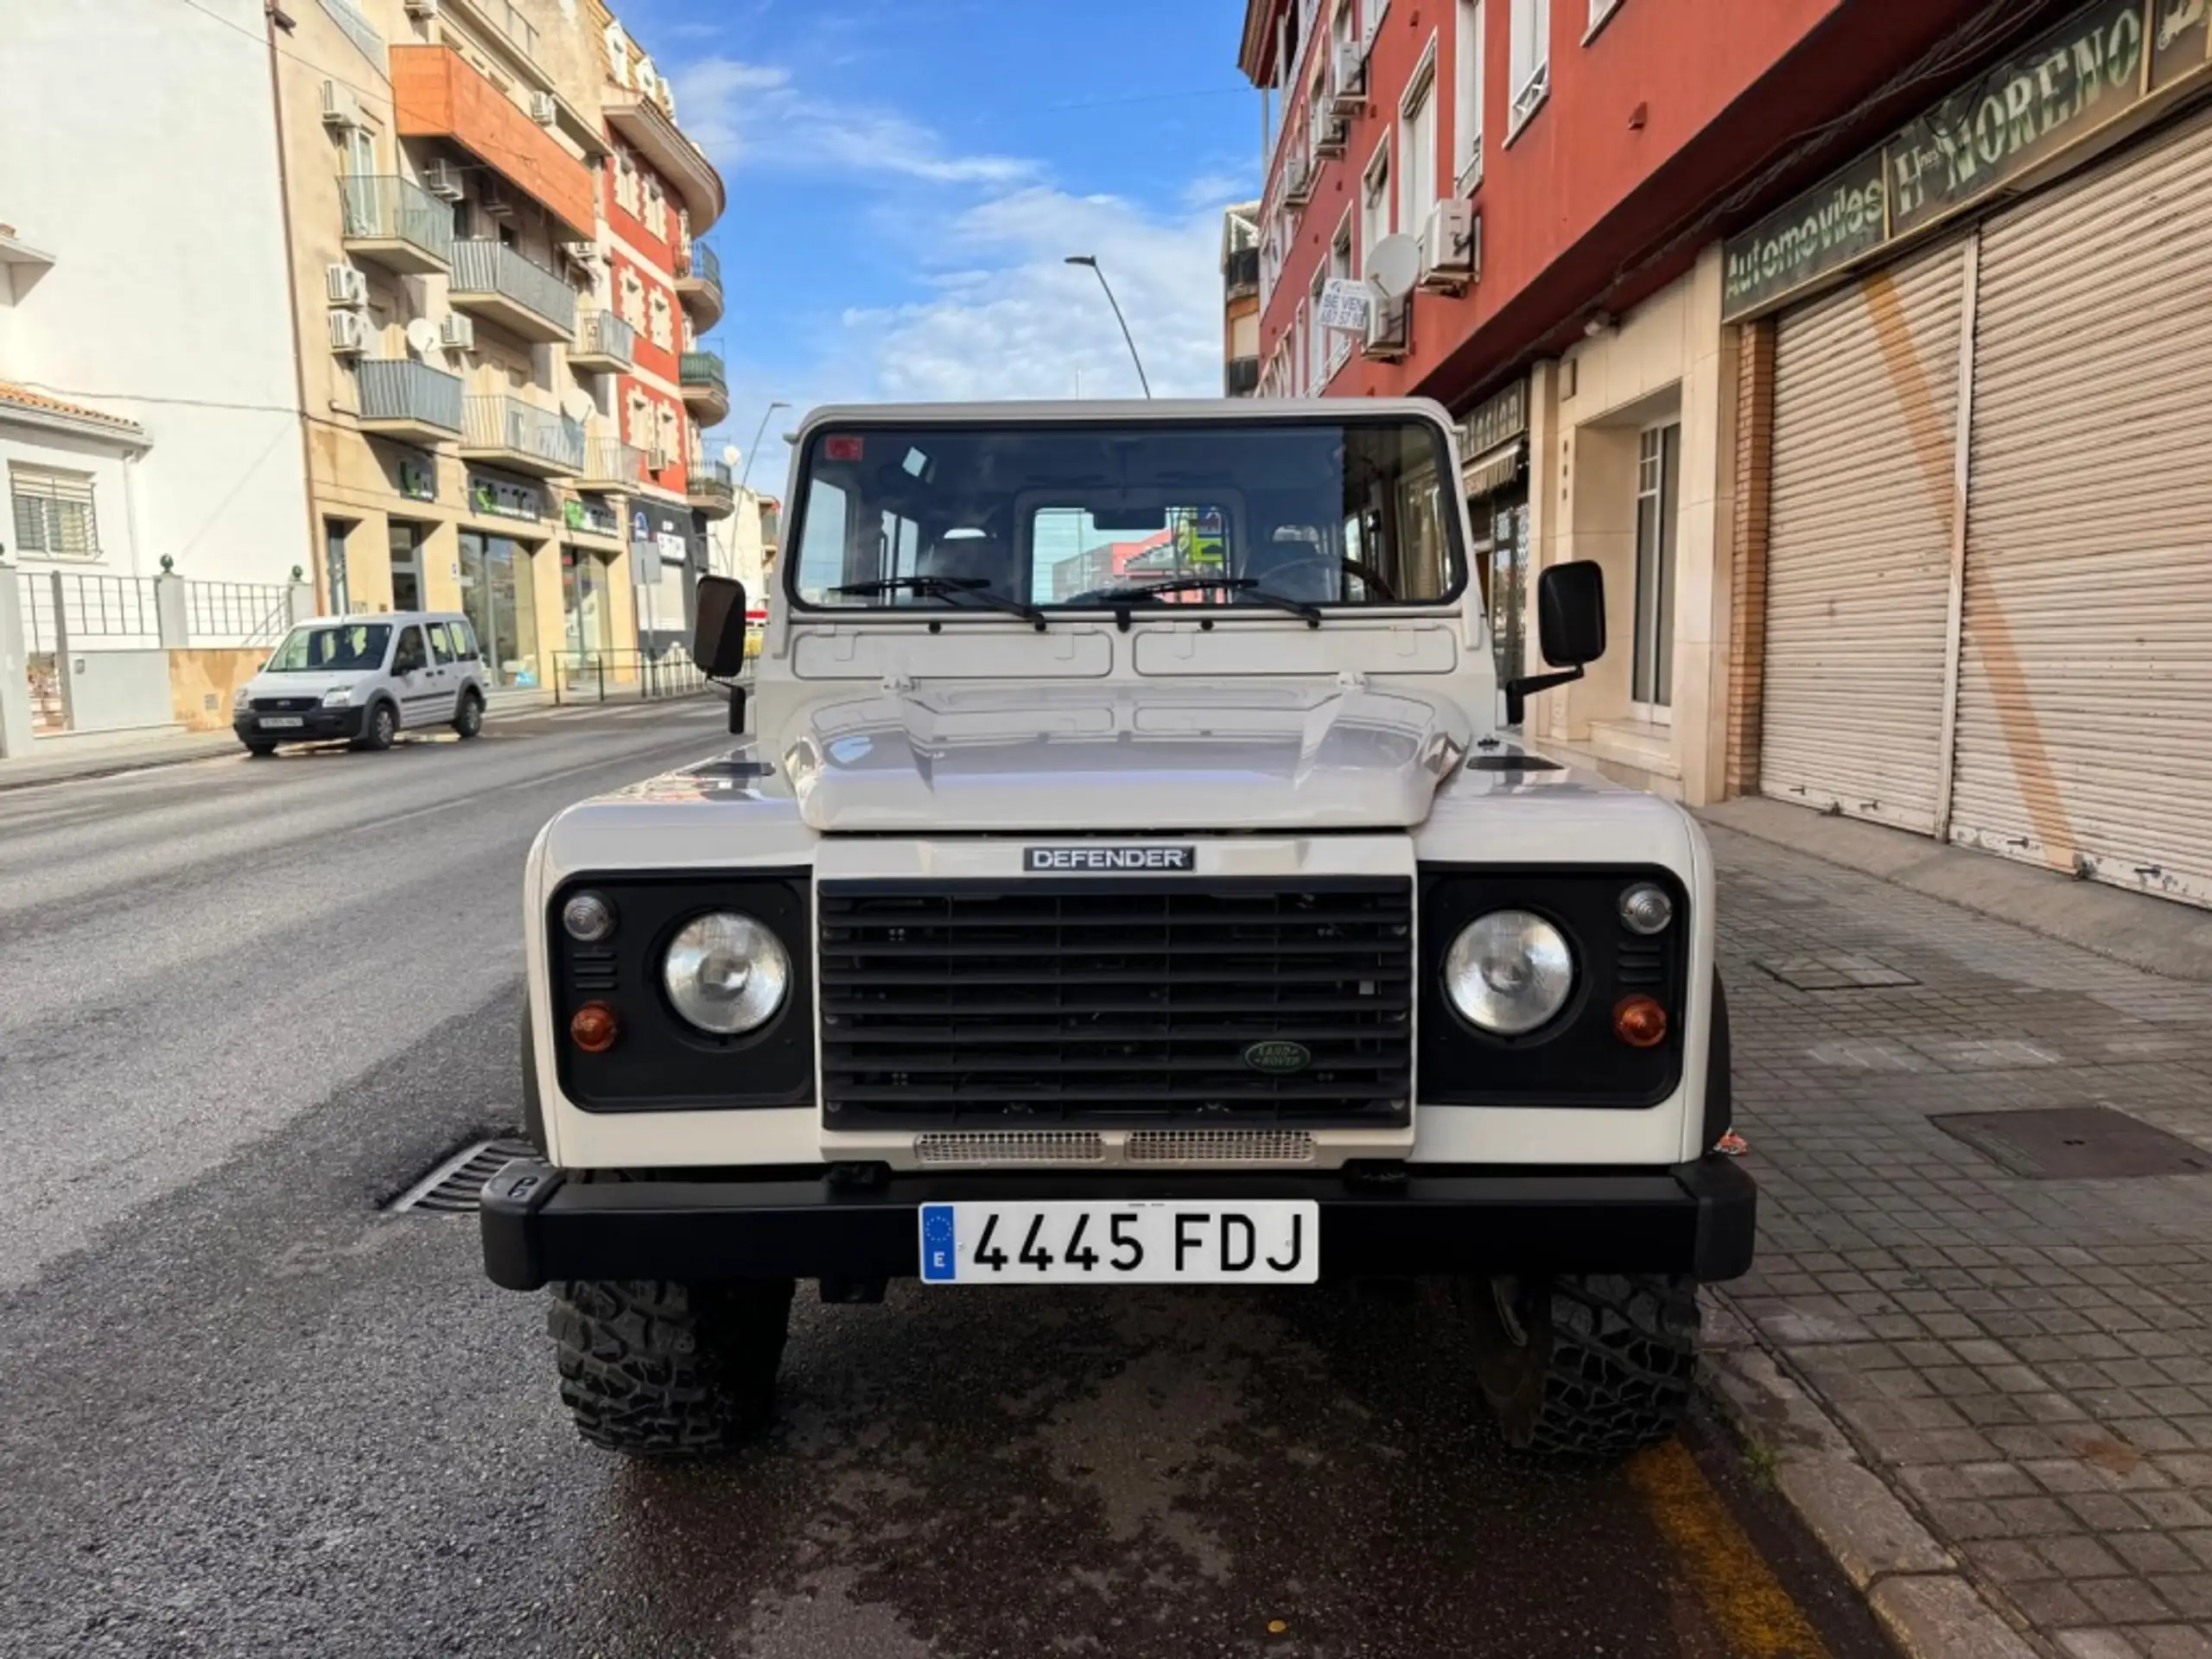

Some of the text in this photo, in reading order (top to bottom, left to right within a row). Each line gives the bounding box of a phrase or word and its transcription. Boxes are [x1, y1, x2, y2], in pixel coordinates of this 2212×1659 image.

[1726, 177, 1884, 300] Automoviles
[1938, 8, 2140, 191] MORENO
[1033, 849, 1184, 868] DEFENDER
[933, 1213, 1302, 1271] E 4445 FDJ
